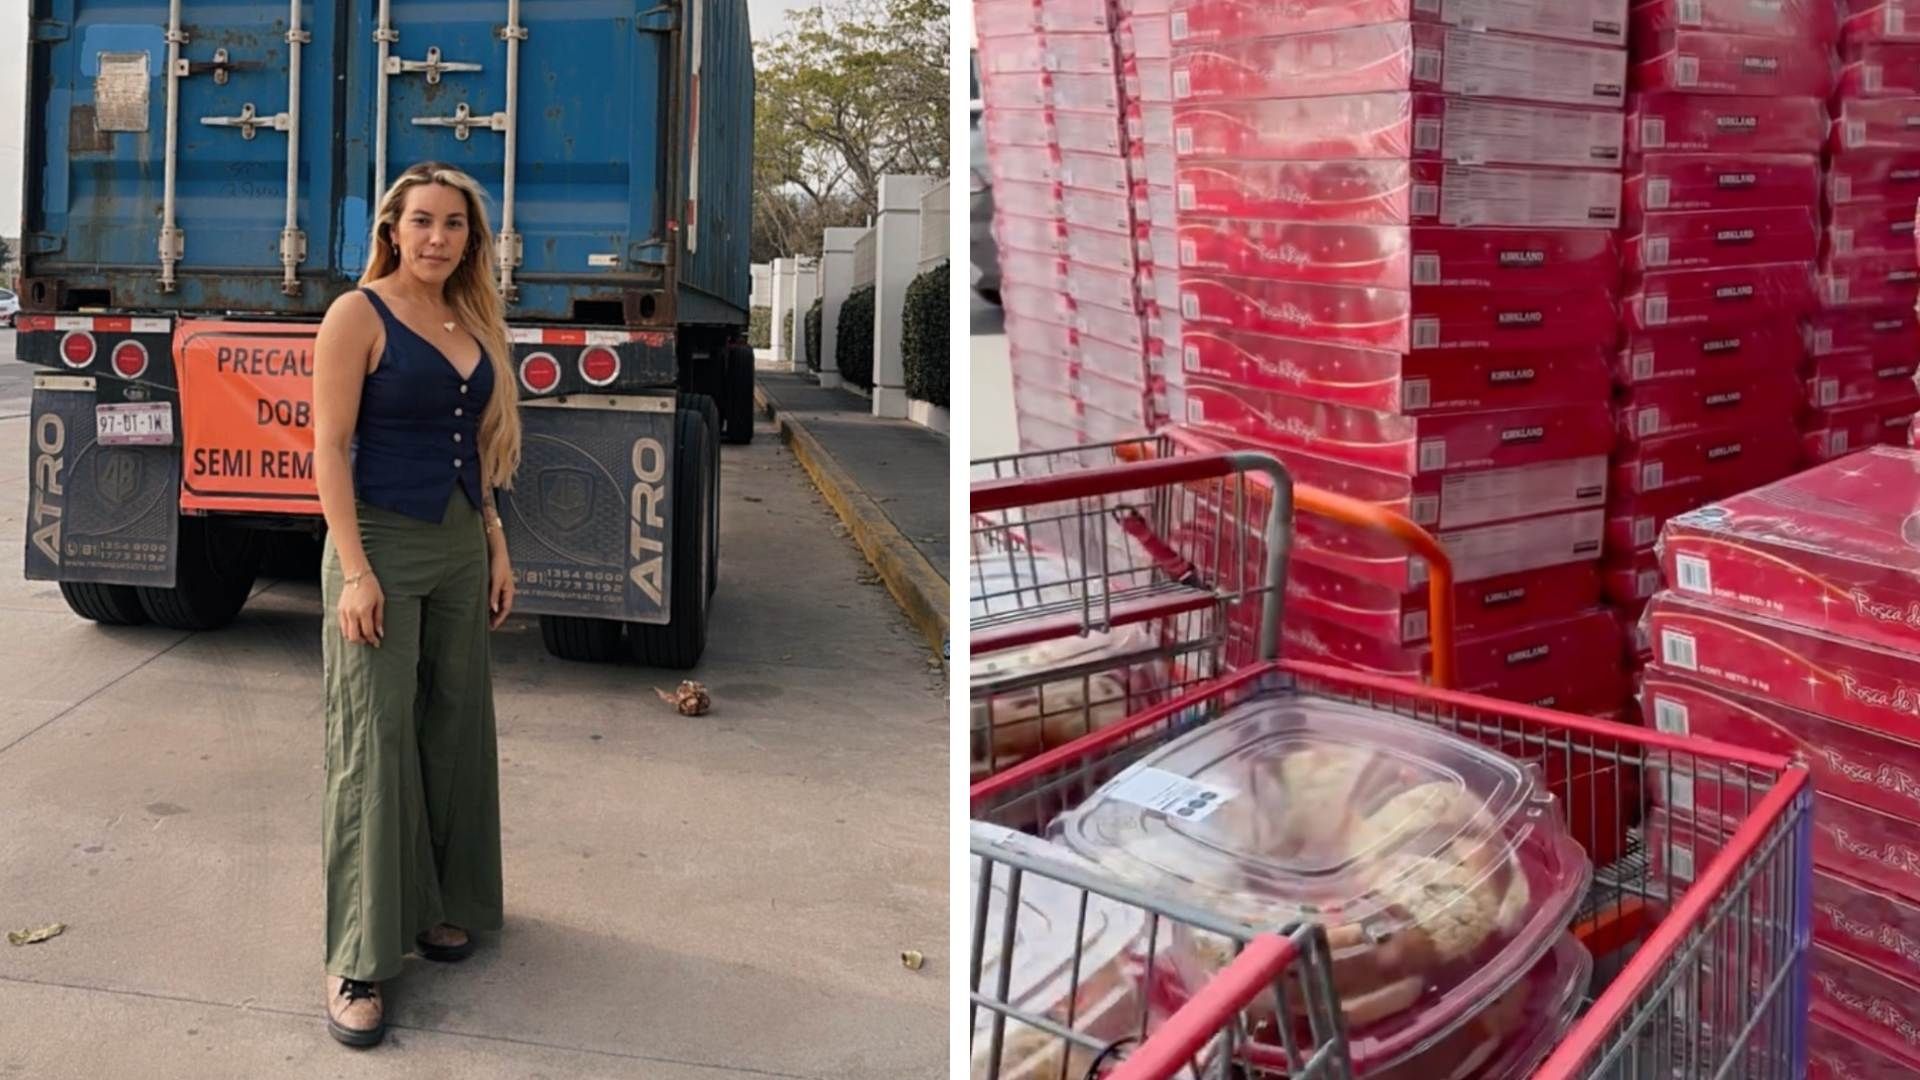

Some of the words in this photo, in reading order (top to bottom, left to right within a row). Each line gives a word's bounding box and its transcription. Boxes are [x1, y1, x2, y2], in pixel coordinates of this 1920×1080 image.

[1717, 117, 1756, 127] KIRKLAND
[1719, 174, 1756, 185] KIRKLAND
[1718, 229, 1755, 241] KIRKLAND
[1501, 251, 1544, 262] KIRKLAND
[1716, 285, 1753, 298] KIRKLAND
[1499, 311, 1542, 323] KIRKLAND
[217, 347, 314, 376] PRECAU
[1491, 368, 1535, 381] KIRKLAND
[257, 398, 310, 427] DOB
[1502, 427, 1543, 440] KIRKLAND
[193, 447, 251, 477] SEMI
[261, 449, 313, 479] REM
[32, 412, 65, 566] ATRO
[630, 437, 665, 607] ATRO
[1852, 590, 1902, 621] Rosca
[1840, 674, 1889, 706] Rosca
[1891, 688, 1912, 711] de
[1828, 749, 1873, 782] Rosca
[1876, 766, 1894, 787] de
[1834, 827, 1879, 861] Rosca
[1829, 907, 1874, 938] Rosca
